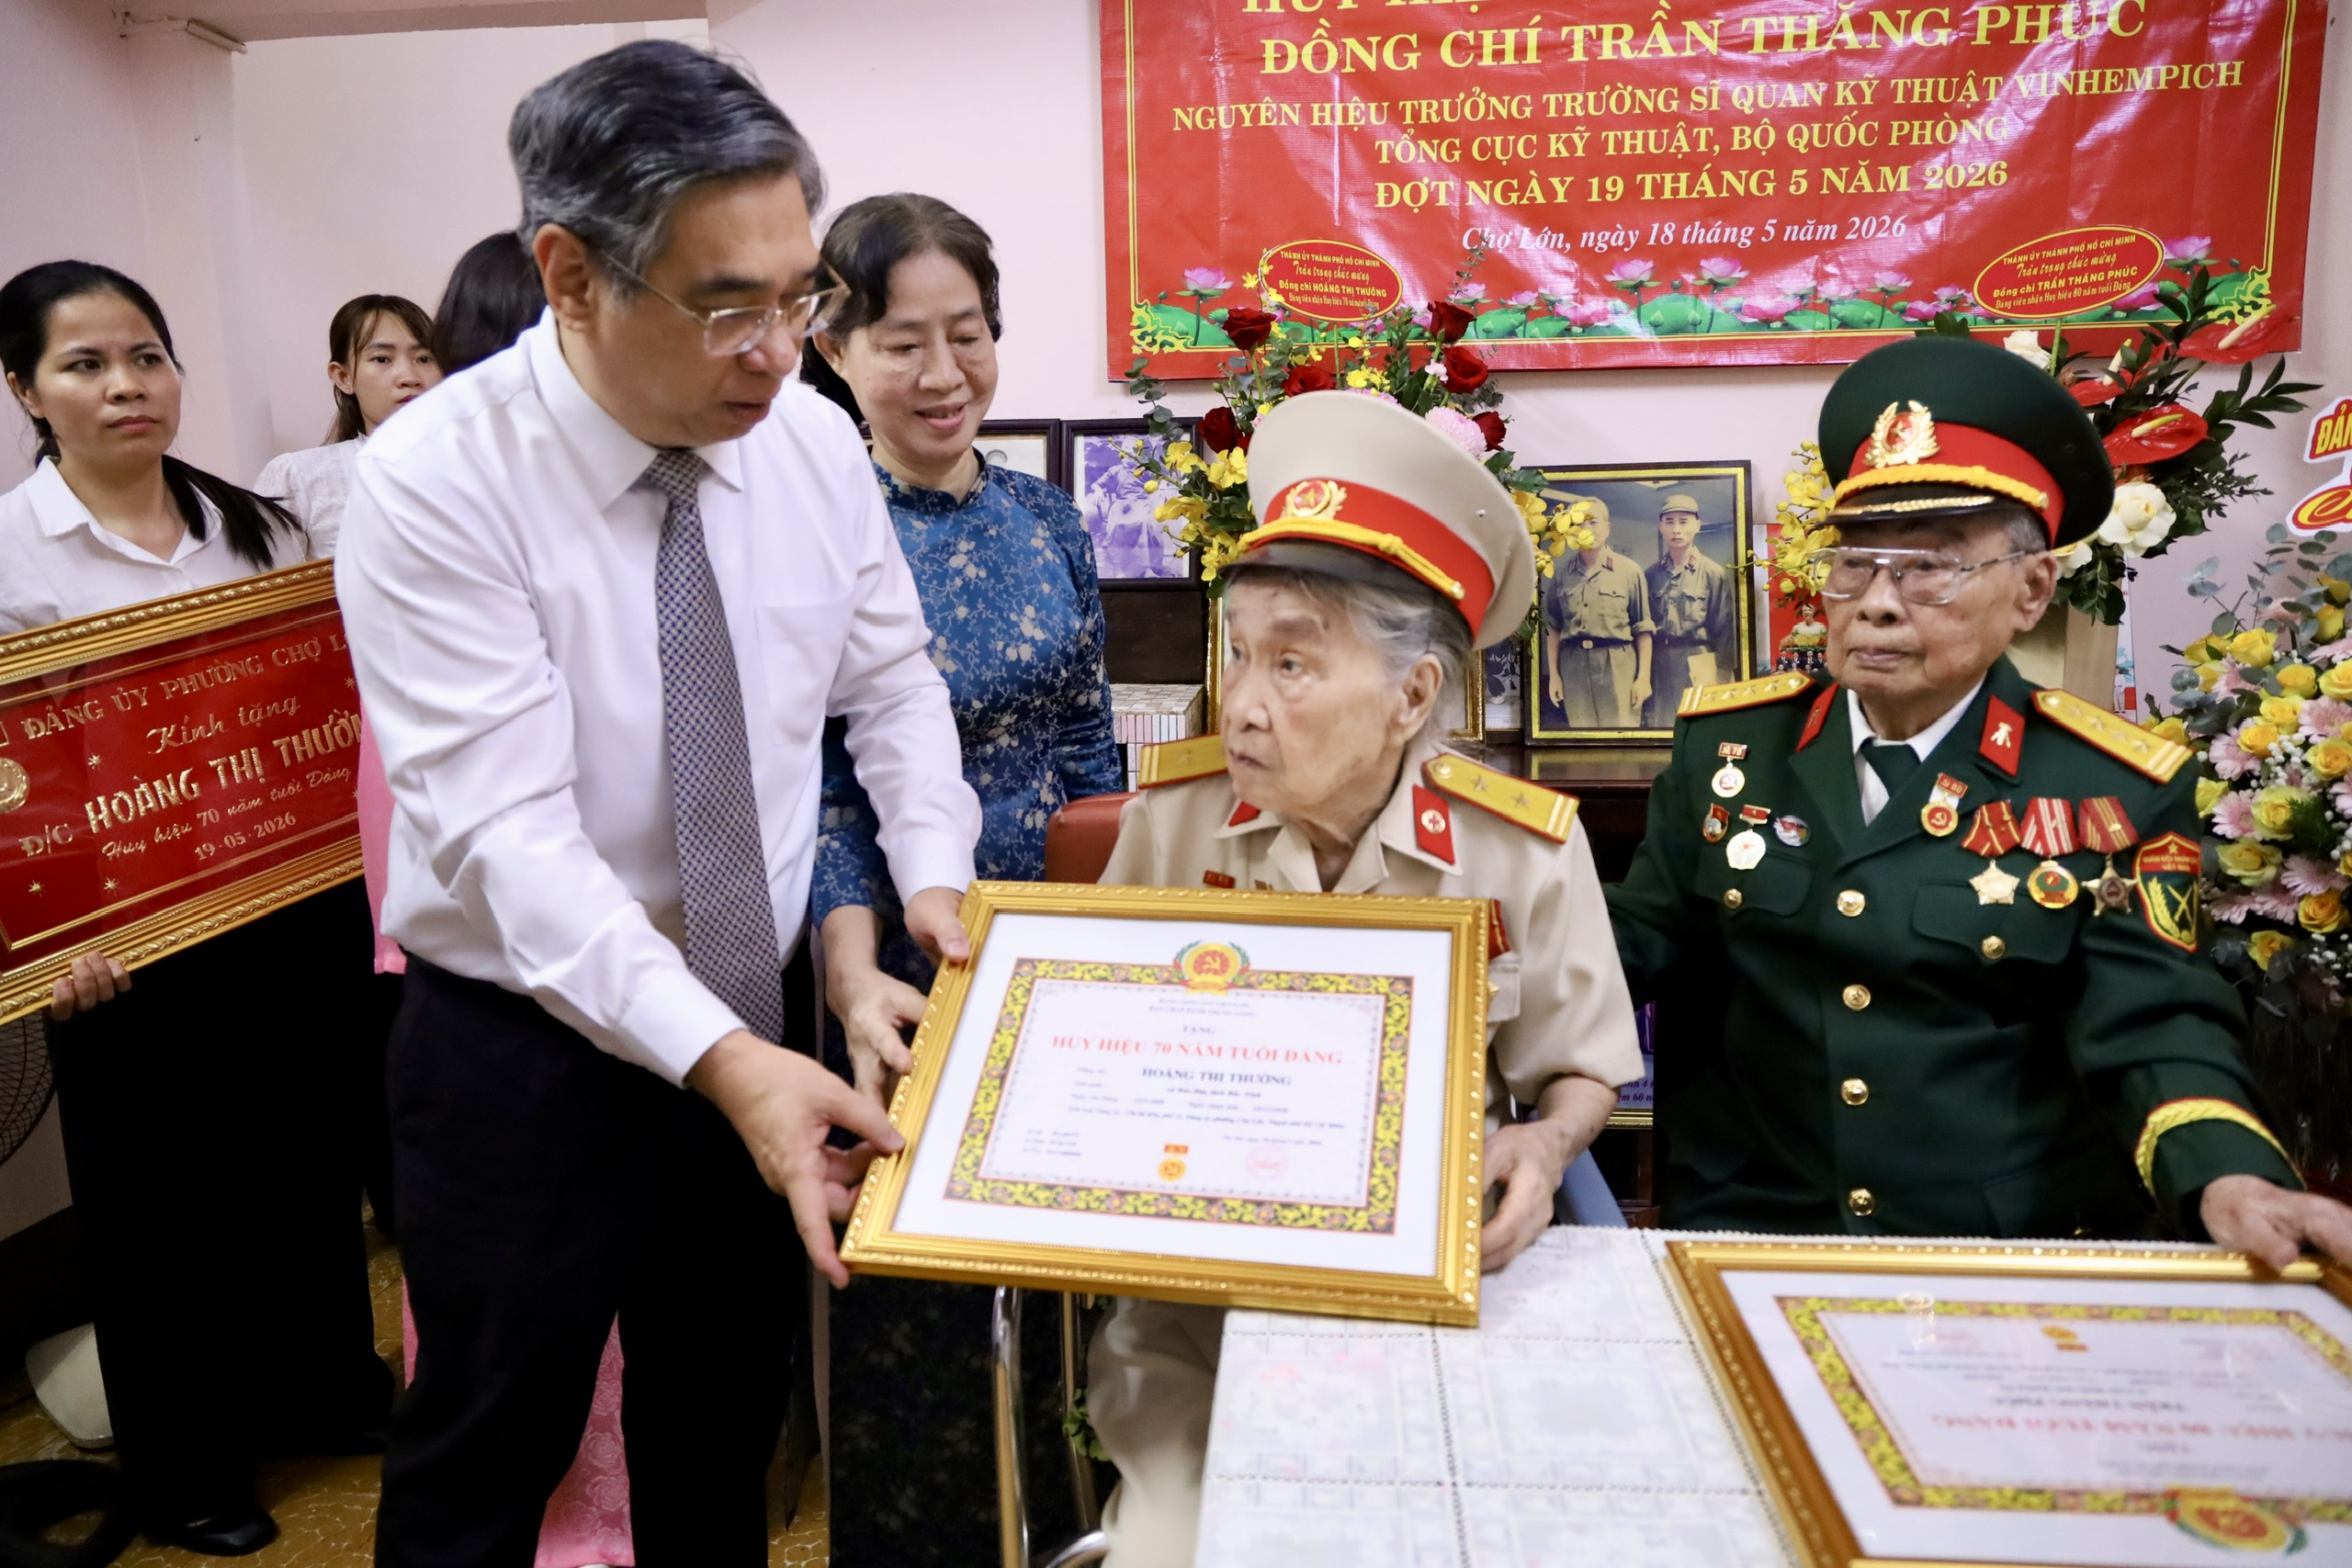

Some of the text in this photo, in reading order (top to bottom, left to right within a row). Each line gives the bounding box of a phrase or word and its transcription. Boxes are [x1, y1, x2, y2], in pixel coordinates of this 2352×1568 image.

[1260, 17, 1422, 74] ĐỒNG
[1440, 15, 1543, 68] CHÍ
[1561, 0, 1724, 62] TRẦN
[1172, 60, 2245, 132] NGUYÊN HIỆU TRƯỞNG TRƯỜNG SĨ QUAN KỸ THUẬT VINHEMPICH
[1374, 111, 2008, 166] TỔNG CỤC KỸ THUẬT, BỘ QUỐC PHÒNG
[1374, 159, 2008, 214] ĐỢT NGÀY 19 THÁNG 5 NĂM 2026
[1462, 215, 1907, 254] Chợ Lớn, ngày 18 tháng 5 năm 2026
[2115, 234, 2136, 246] MINH
[1341, 285, 1355, 297] THỊ
[1993, 284, 2018, 299] Đồng
[2108, 265, 2139, 280] PHÚC
[2073, 288, 2083, 299] 80
[21, 699, 104, 740] ĐẢNG
[111, 686, 148, 712] ỦY
[159, 655, 265, 700] PHƯỜNG
[271, 636, 322, 667] CHỢ
[146, 695, 300, 754] Kính tặng
[85, 767, 201, 834] HOÀNG
[208, 746, 266, 790] THỊ
[101, 838, 148, 861] Huy
[153, 822, 193, 843] hiệu
[196, 807, 220, 828] 70
[227, 797, 263, 817] năm
[1052, 1034, 1093, 1052] HUY
[1098, 1037, 1148, 1055] HIỆU
[1153, 1041, 1171, 1055] 70
[1141, 1066, 1194, 1082] HOÀNG
[1199, 1070, 1225, 1084] THỊ
